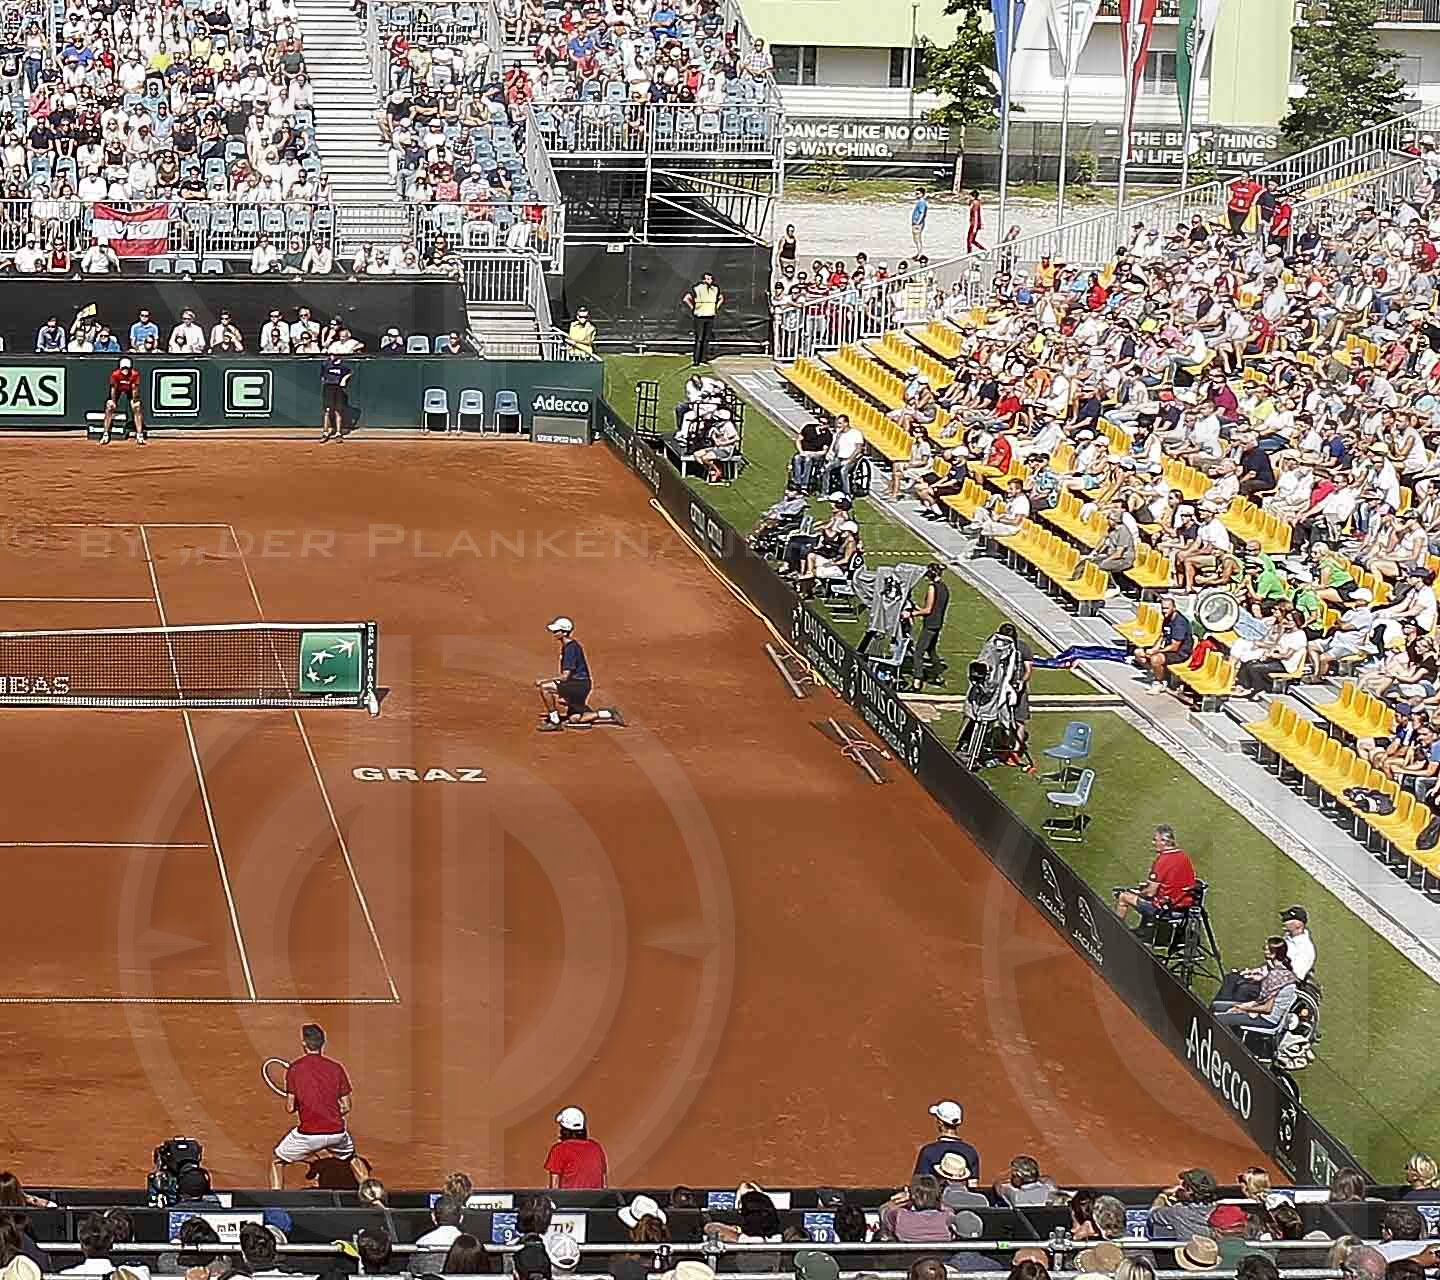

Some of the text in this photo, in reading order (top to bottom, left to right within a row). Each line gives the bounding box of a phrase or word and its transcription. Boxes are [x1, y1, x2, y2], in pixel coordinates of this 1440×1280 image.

[843, 124, 881, 139] LIKE
[884, 125, 909, 140] NO
[913, 126, 950, 141] ONE
[1130, 131, 1160, 146] THE
[1218, 132, 1277, 149] THINGS
[800, 142, 893, 157] WATCHING.
[1148, 150, 1184, 164] LIFE
[1227, 152, 1269, 166] LIVE.
[532, 394, 589, 413] Adecco
[860, 670, 907, 732] DAVIS CUP
[351, 767, 488, 782] GRAZ
[1185, 1016, 1252, 1121] Adecco
[504, 1229, 513, 1241] 9
[813, 1228, 827, 1242] 10
